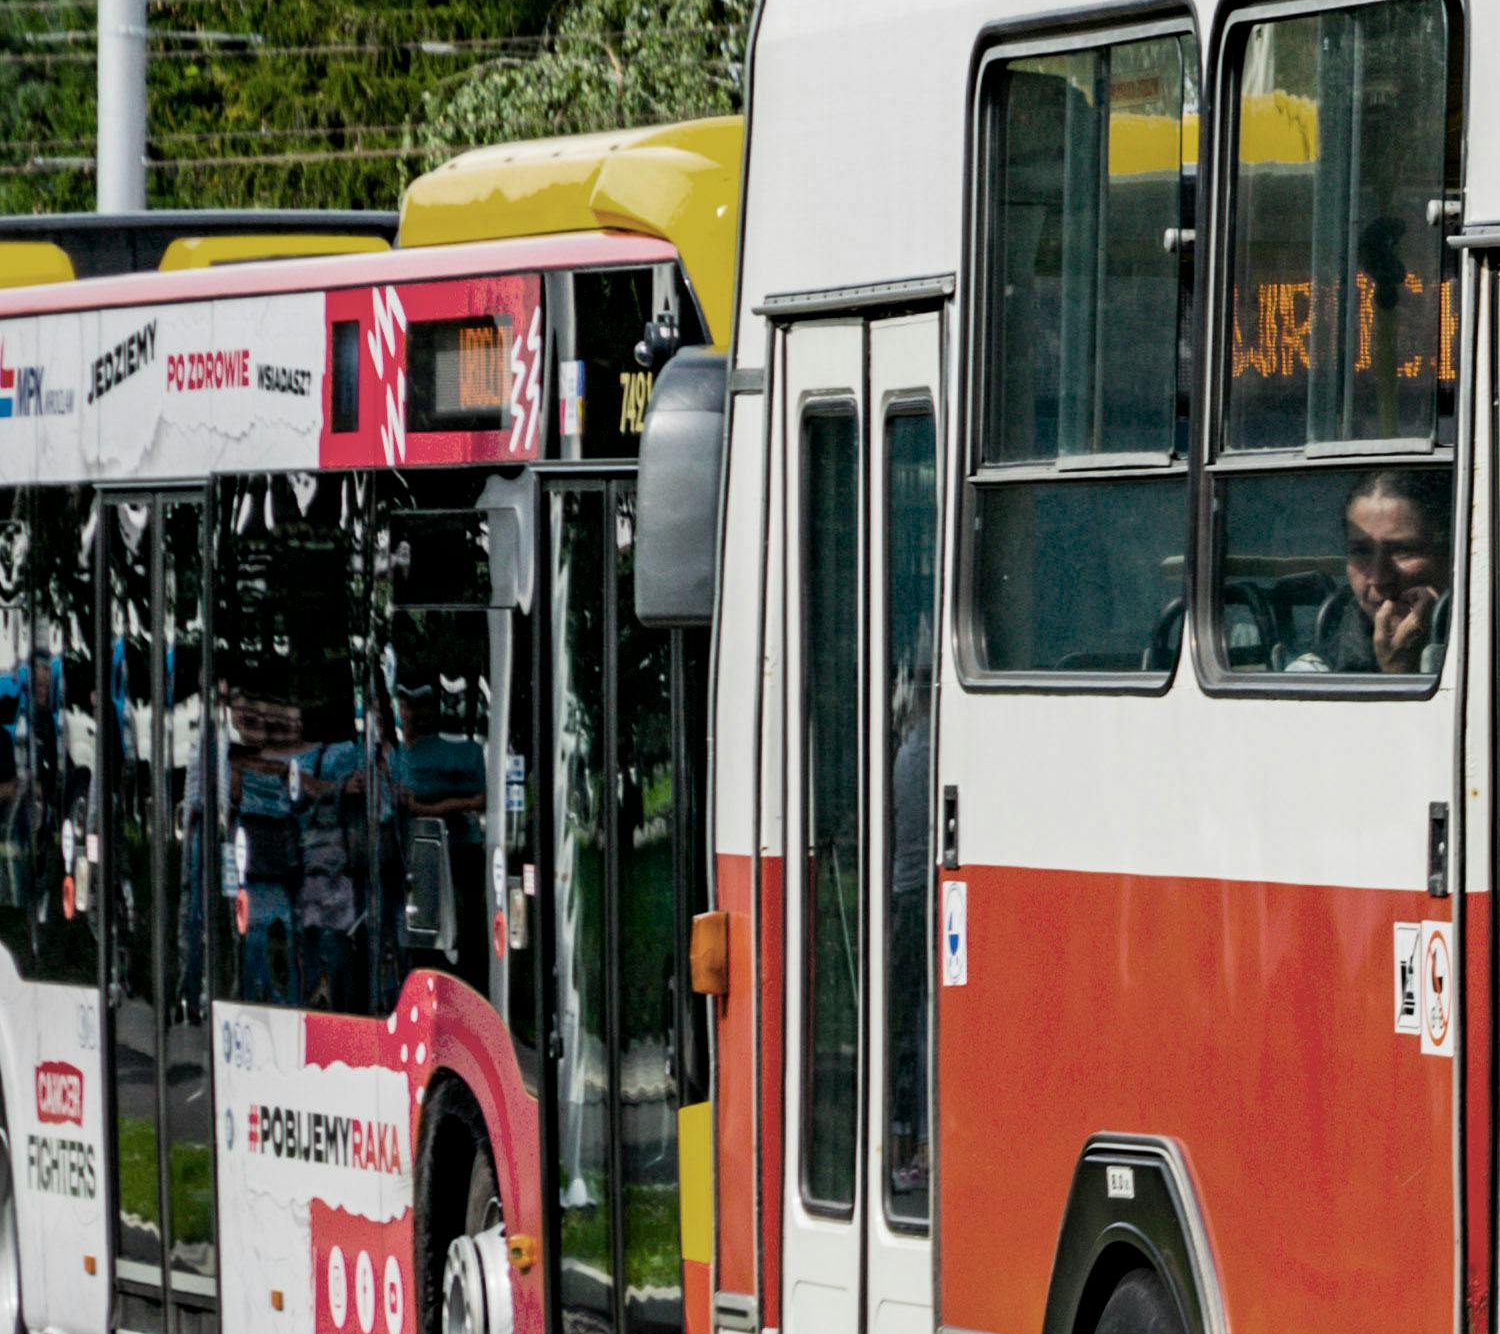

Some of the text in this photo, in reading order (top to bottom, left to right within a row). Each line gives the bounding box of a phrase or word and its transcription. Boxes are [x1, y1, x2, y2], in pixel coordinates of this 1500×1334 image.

[16, 364, 44, 417] MPK
[87, 318, 158, 405] JEDZIEMY
[166, 353, 185, 392] PO
[187, 349, 250, 391] ZDROWIE
[37, 1069, 82, 1118] CANCER
[27, 1133, 96, 1199] FIGHTERS
[248, 1104, 403, 1177] #POBIJEMYRAKA
